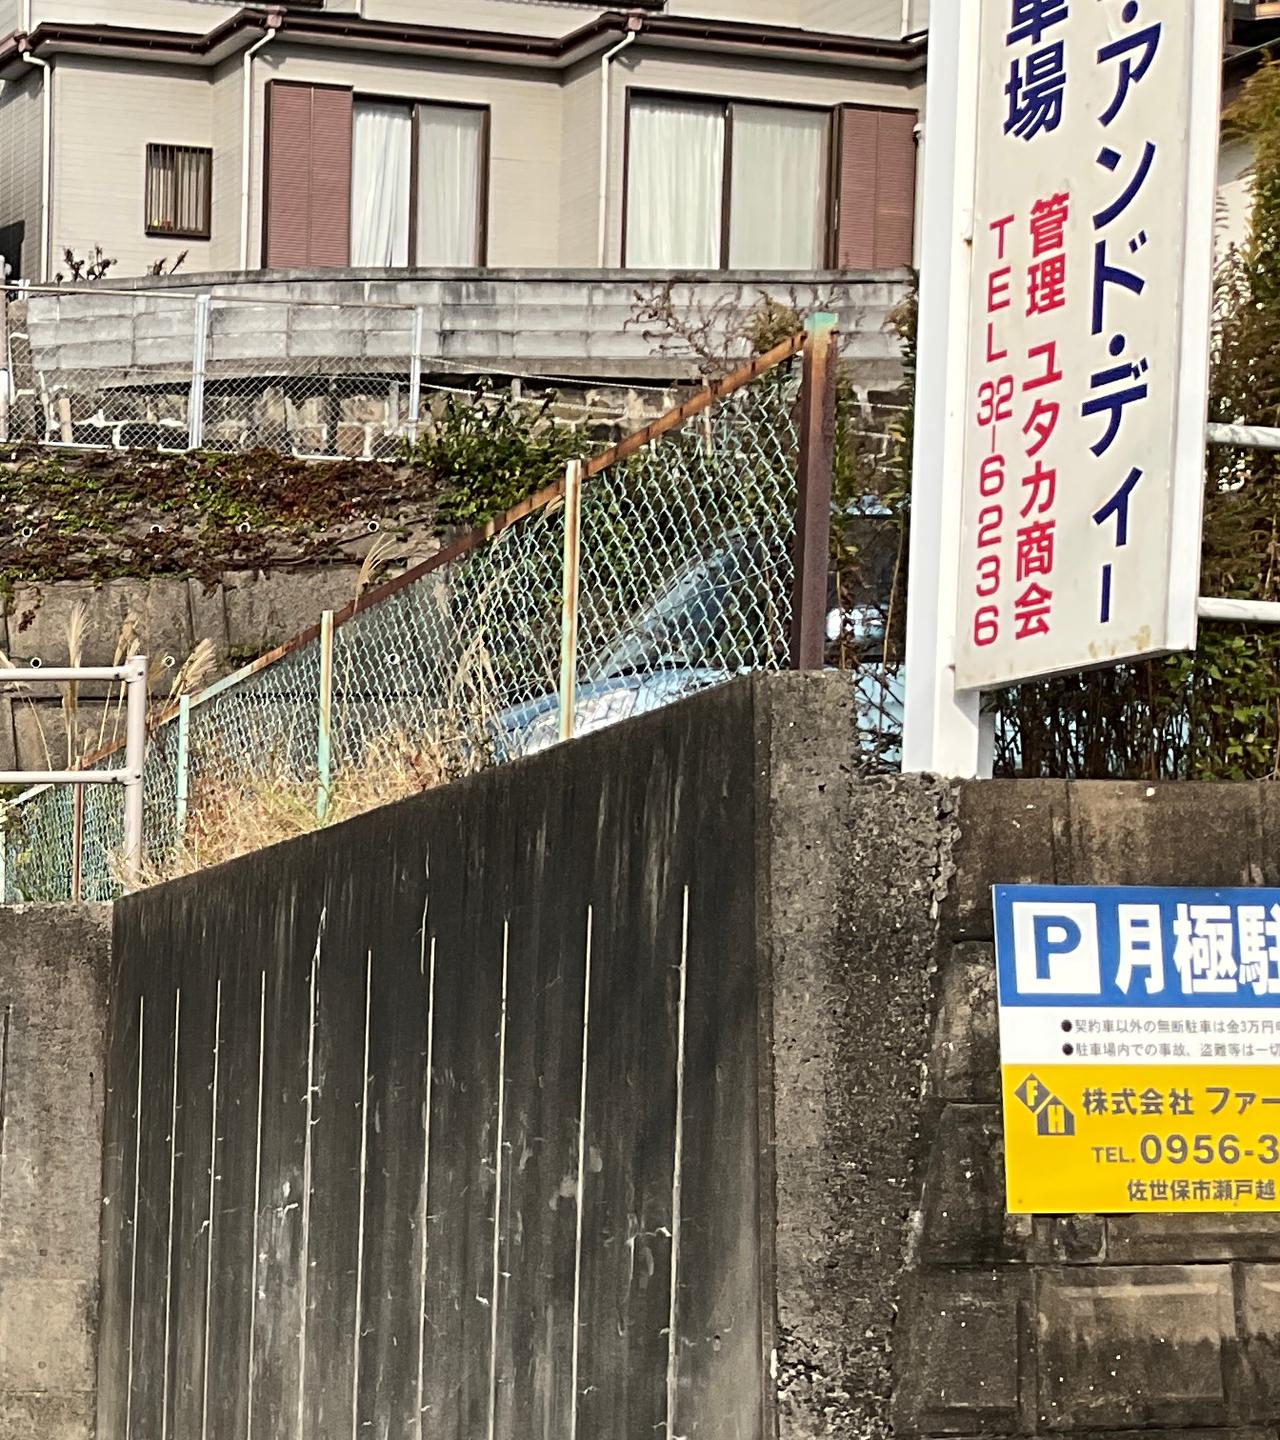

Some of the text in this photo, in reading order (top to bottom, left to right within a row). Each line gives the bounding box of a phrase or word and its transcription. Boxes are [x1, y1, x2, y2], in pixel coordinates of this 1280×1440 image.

[1033, 915, 1082, 980] P
[1082, 1087, 1195, 1115] 株式会社
